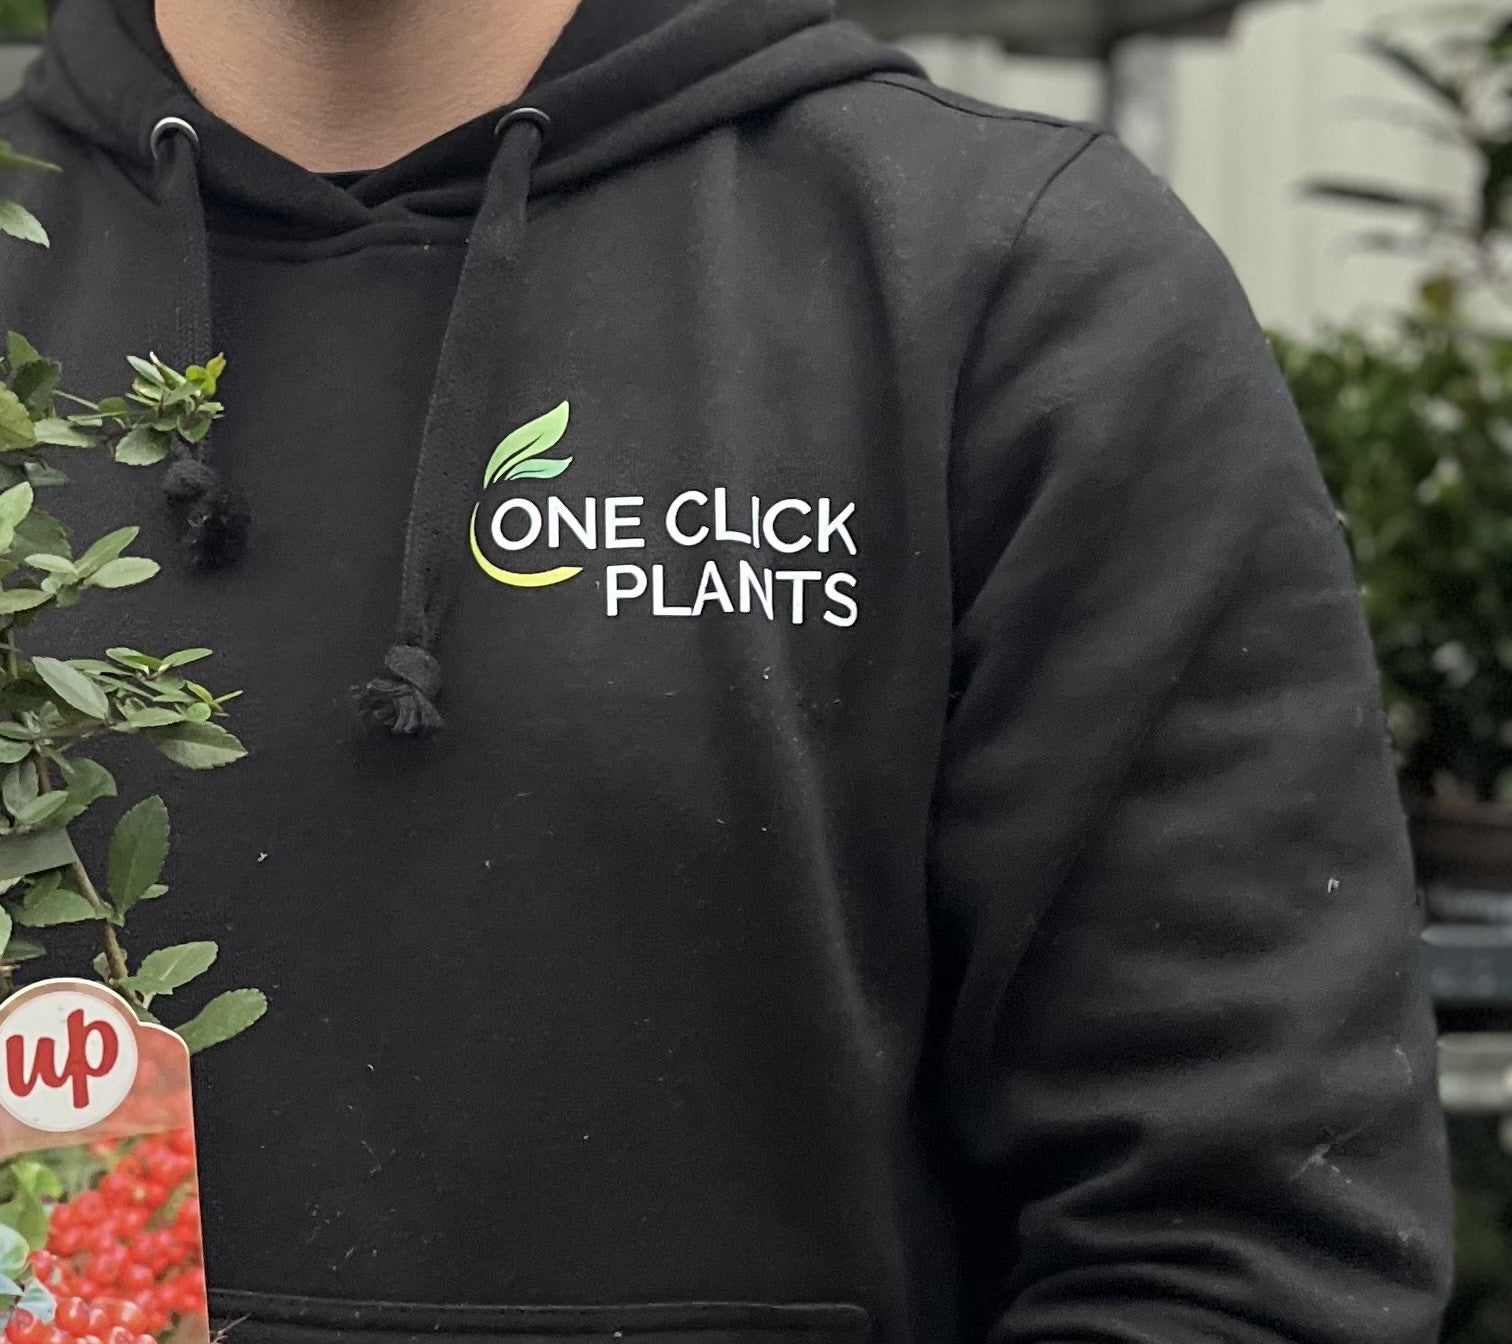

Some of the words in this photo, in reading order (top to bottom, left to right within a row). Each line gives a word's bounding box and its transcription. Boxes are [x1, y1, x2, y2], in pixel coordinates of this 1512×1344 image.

[491, 495, 646, 552] ONE
[665, 487, 858, 556] CLICK
[605, 559, 858, 628] PLANTS
[6, 1009, 119, 1109] up
